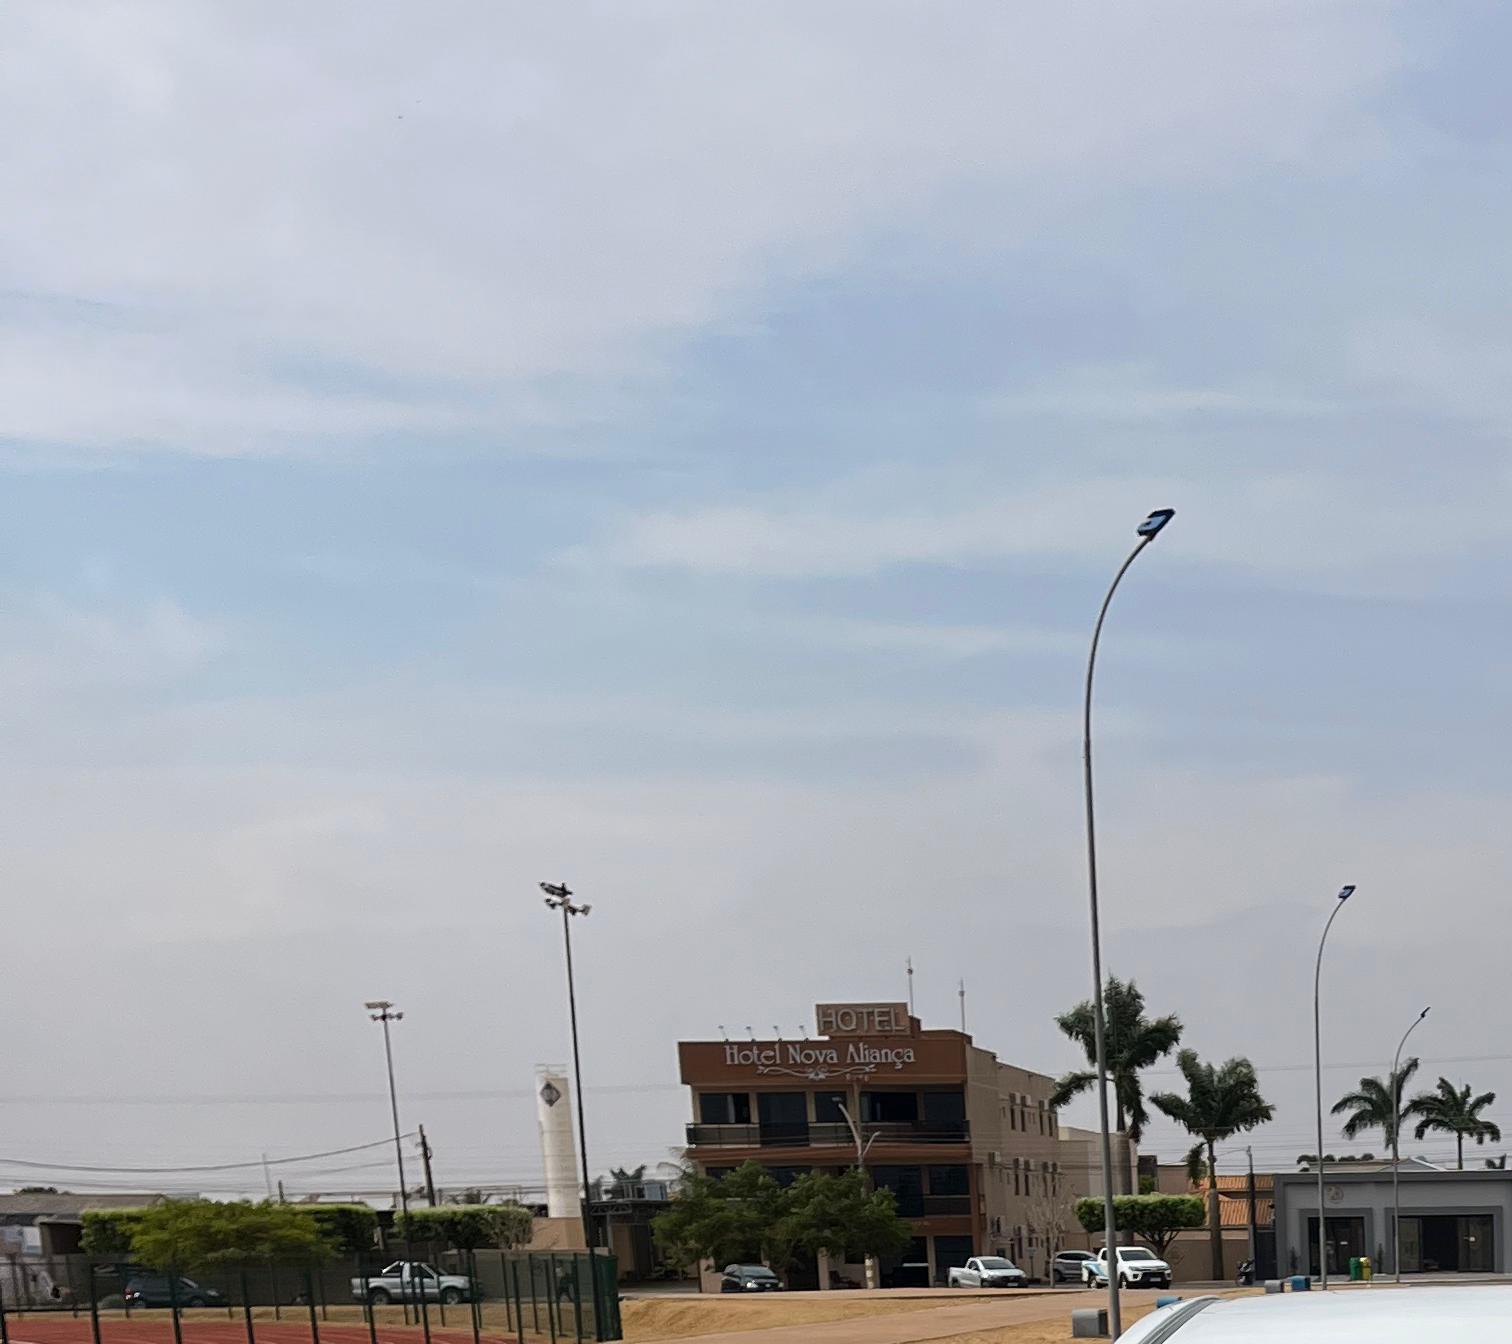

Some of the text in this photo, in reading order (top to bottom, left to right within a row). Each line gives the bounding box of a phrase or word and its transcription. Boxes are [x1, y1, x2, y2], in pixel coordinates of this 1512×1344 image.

[818, 1007, 906, 1032] HOTEL
[724, 1042, 916, 1069] Hotel Nova Aliança
